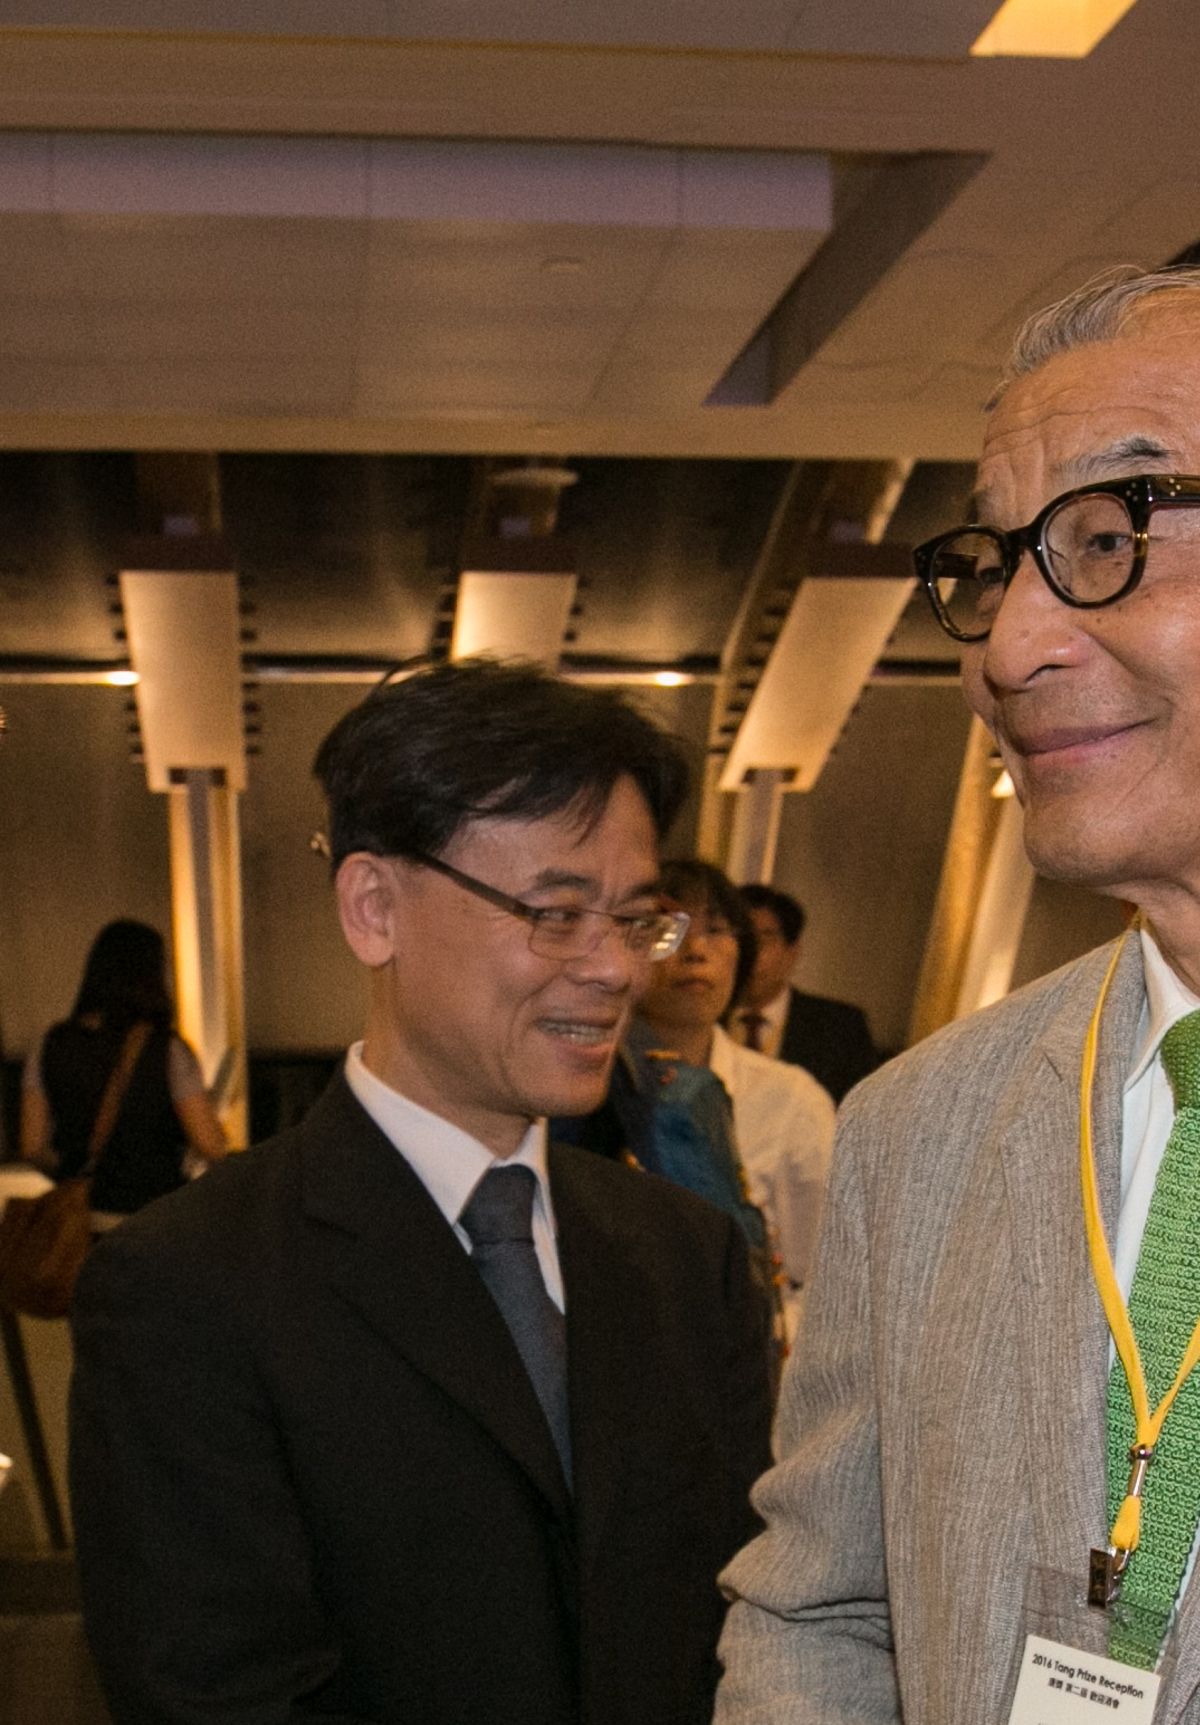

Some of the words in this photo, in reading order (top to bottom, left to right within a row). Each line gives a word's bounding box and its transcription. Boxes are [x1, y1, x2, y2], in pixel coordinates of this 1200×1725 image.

[1032, 1653, 1052, 1669] 2016
[1054, 1660, 1075, 1677] Tang
[1076, 1667, 1097, 1683] Prize
[1099, 1675, 1144, 1699] Reception
